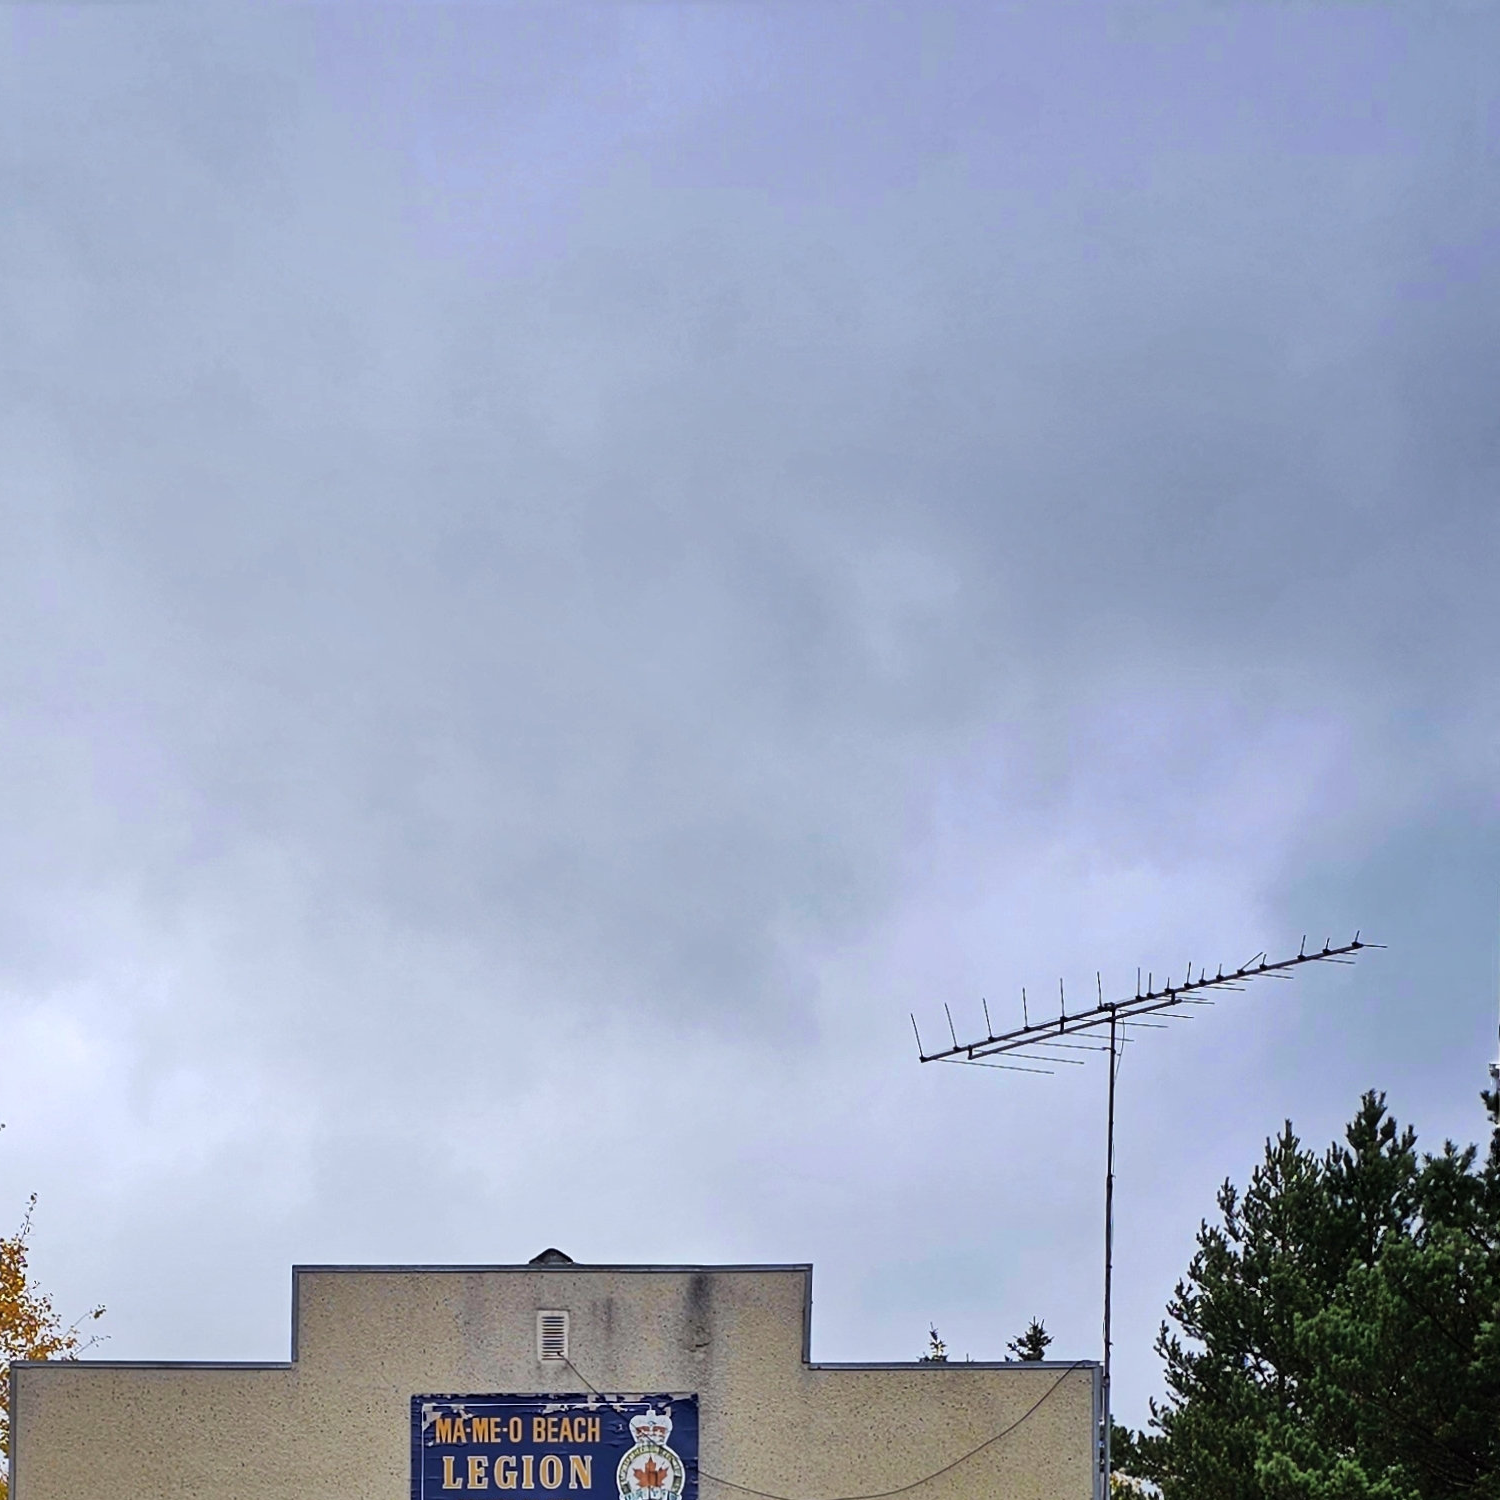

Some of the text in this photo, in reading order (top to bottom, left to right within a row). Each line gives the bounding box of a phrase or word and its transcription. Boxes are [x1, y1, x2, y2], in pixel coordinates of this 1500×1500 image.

[435, 1416, 601, 1443] MA-ME-O BEACH
[442, 1455, 593, 1490] LEGION
